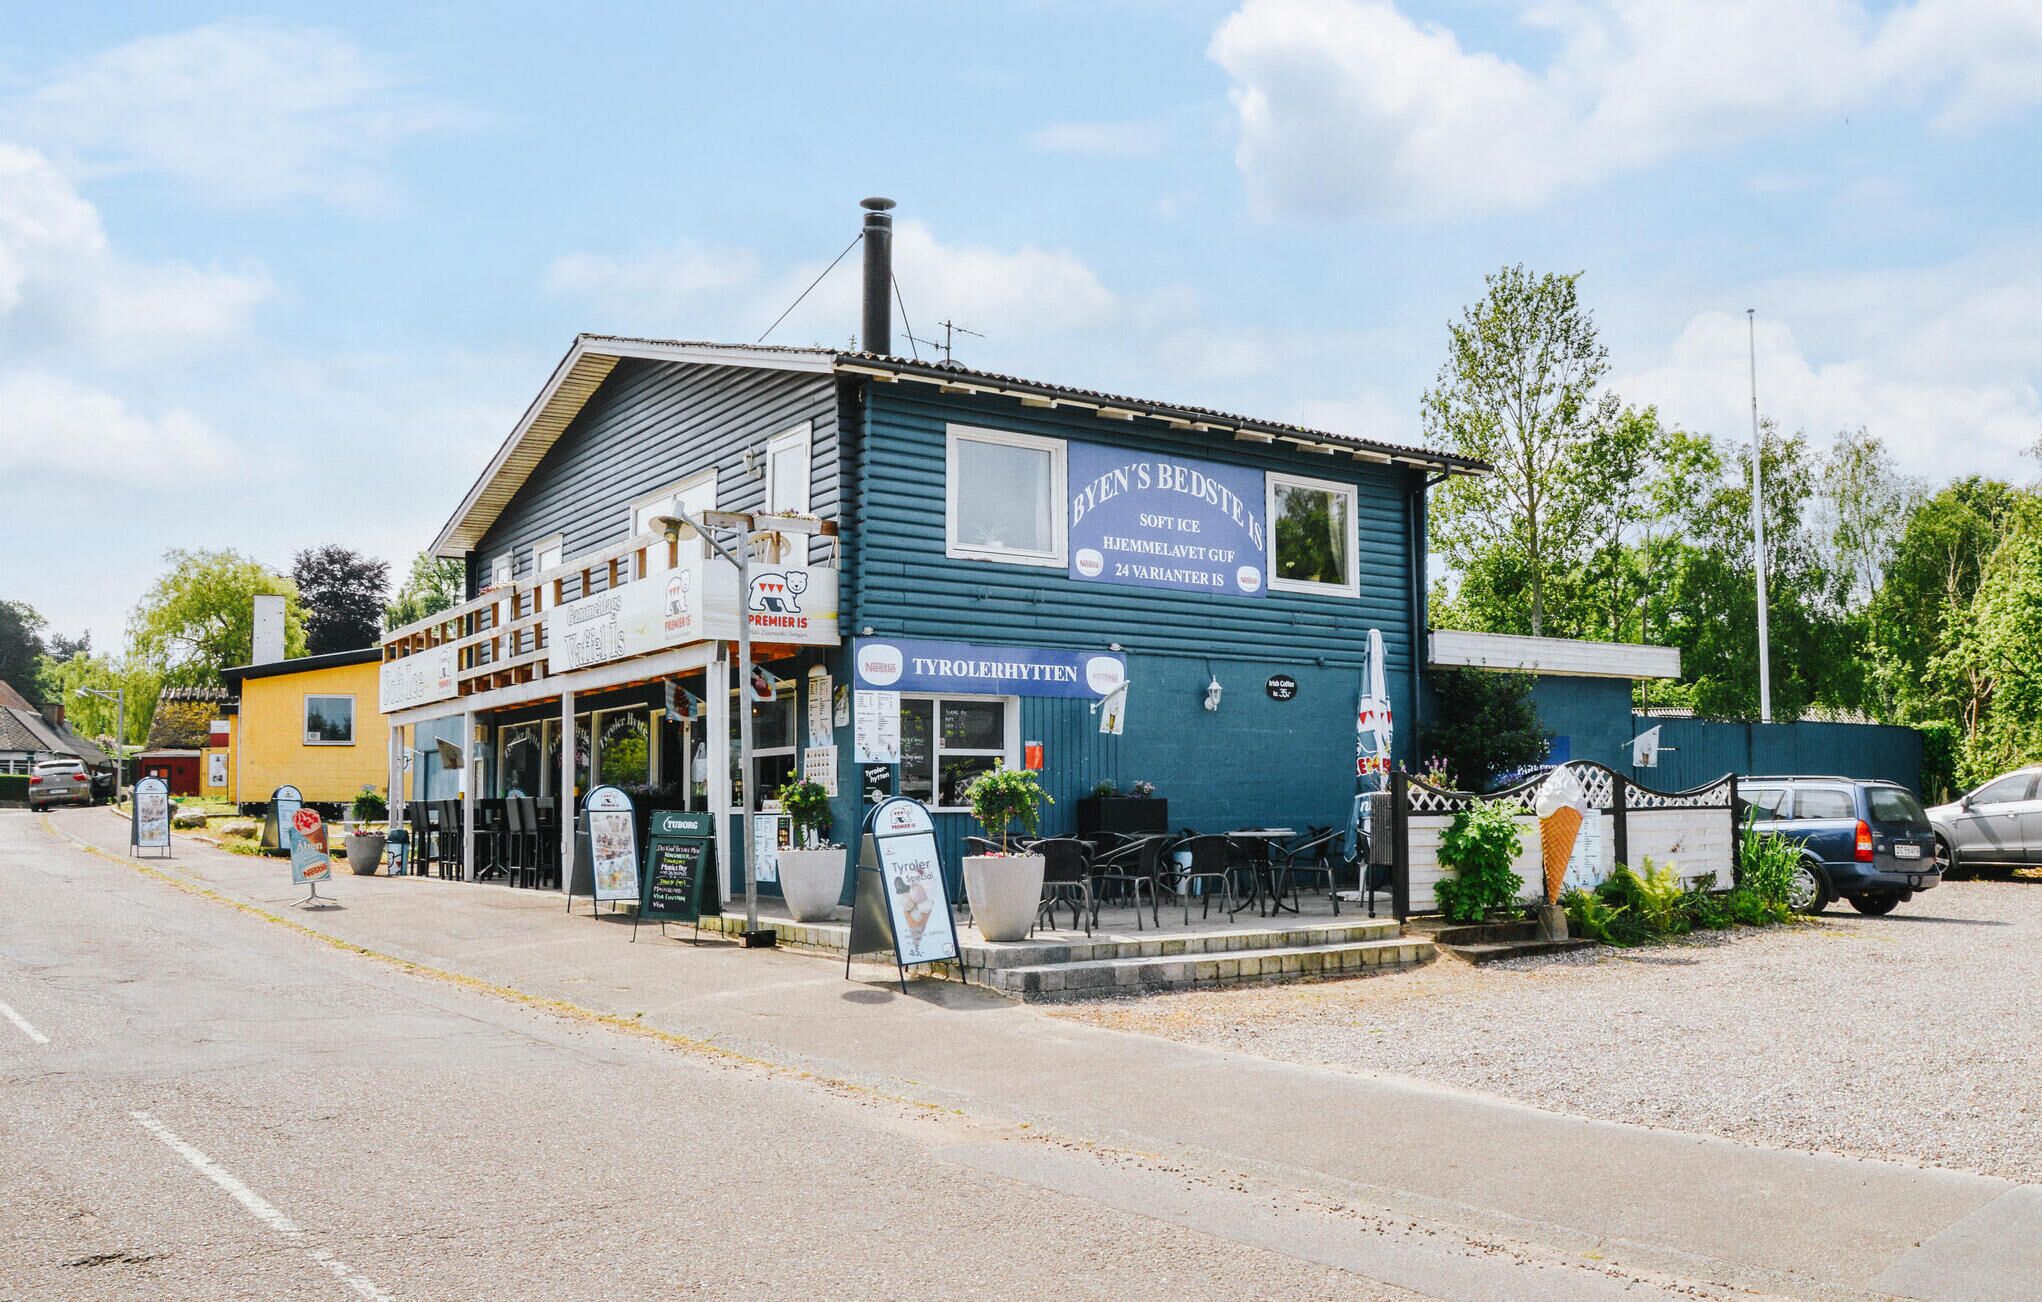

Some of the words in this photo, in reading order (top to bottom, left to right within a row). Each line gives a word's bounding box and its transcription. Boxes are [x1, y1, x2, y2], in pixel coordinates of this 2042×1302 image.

[1157, 463, 1244, 527] BEDSTE
[1248, 511, 1263, 552] IS
[1140, 513, 1174, 530] SOFT
[1177, 518, 1200, 533] ICE
[1103, 536, 1206, 560] HJEMMELAVET
[1209, 549, 1236, 563] GUF
[1115, 563, 1129, 577] 24
[1132, 565, 1209, 585] VARIANTER
[1212, 574, 1224, 587] IS
[748, 614, 795, 628] PREMIER
[797, 617, 808, 629] IS
[912, 658, 1077, 682] TYROLERHYTTEN
[668, 820, 698, 830] TUBORG
[891, 859, 931, 875] Tyroler
[905, 872, 934, 883] Special
